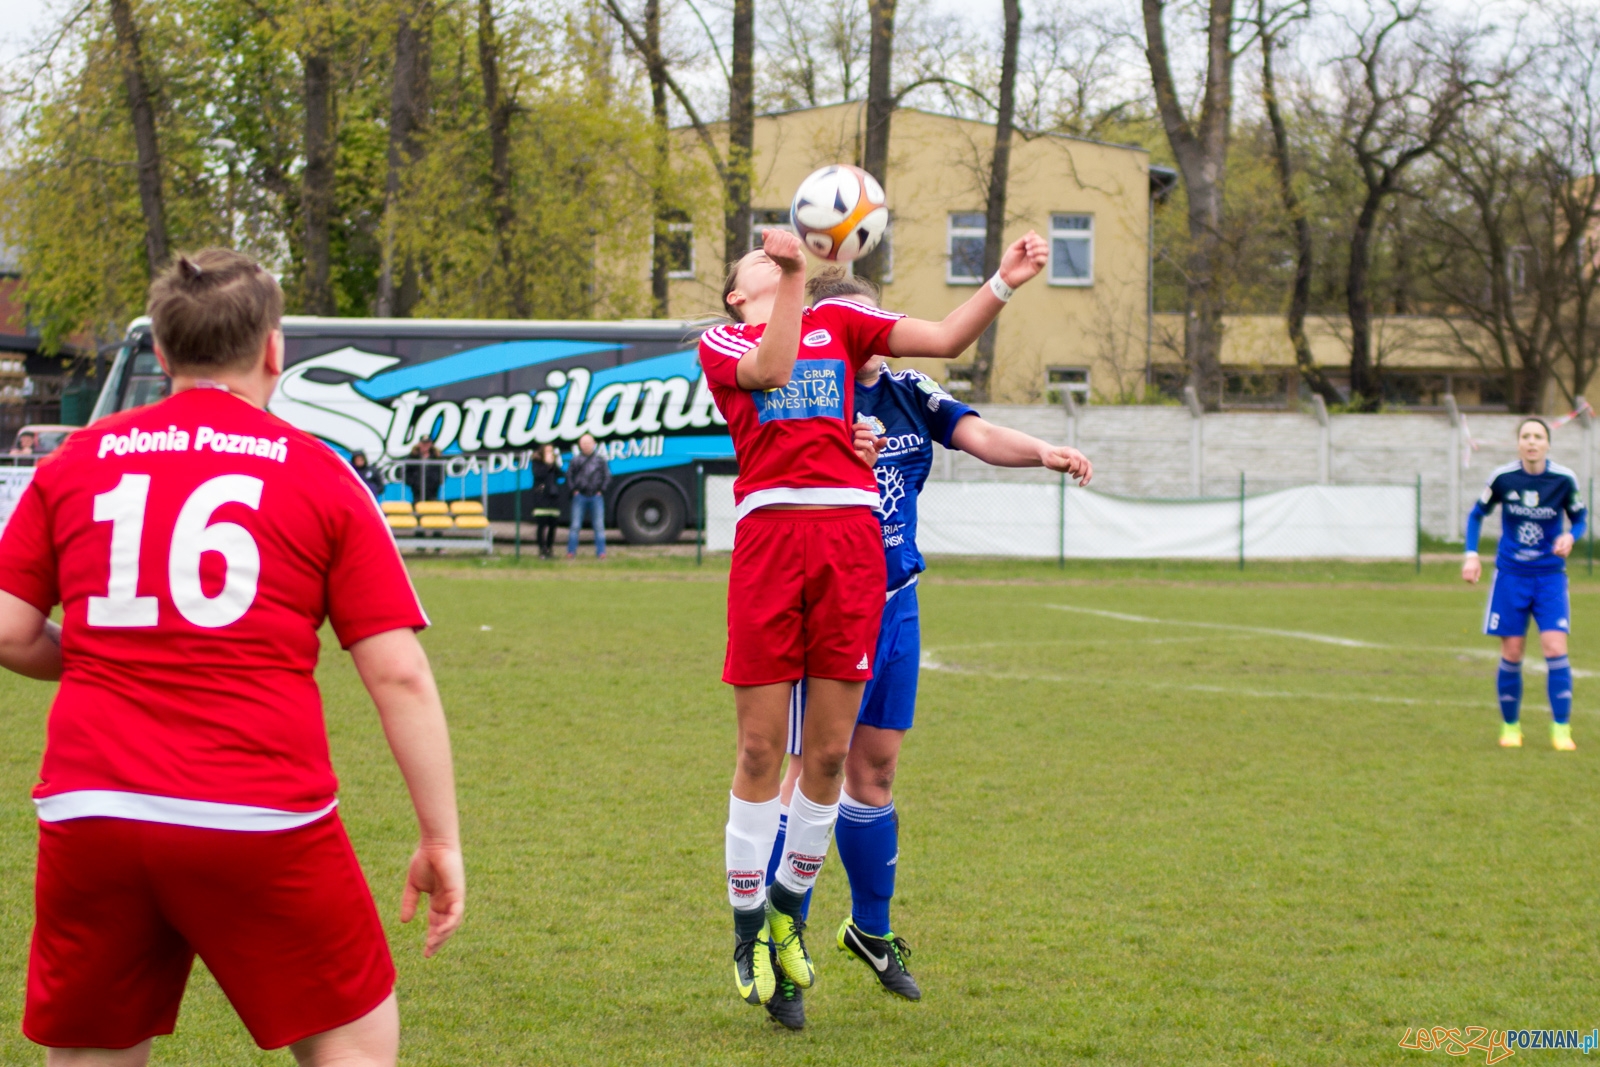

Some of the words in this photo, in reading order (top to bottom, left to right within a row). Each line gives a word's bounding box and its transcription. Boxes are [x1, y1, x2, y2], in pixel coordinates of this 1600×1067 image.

[803, 369, 837, 379] GRUPA
[765, 396, 840, 411] INVESTMENT
[97, 425, 190, 459] Polonia
[194, 426, 288, 463] Poznań
[87, 473, 264, 628] 16
[1489, 612, 1501, 630] 6
